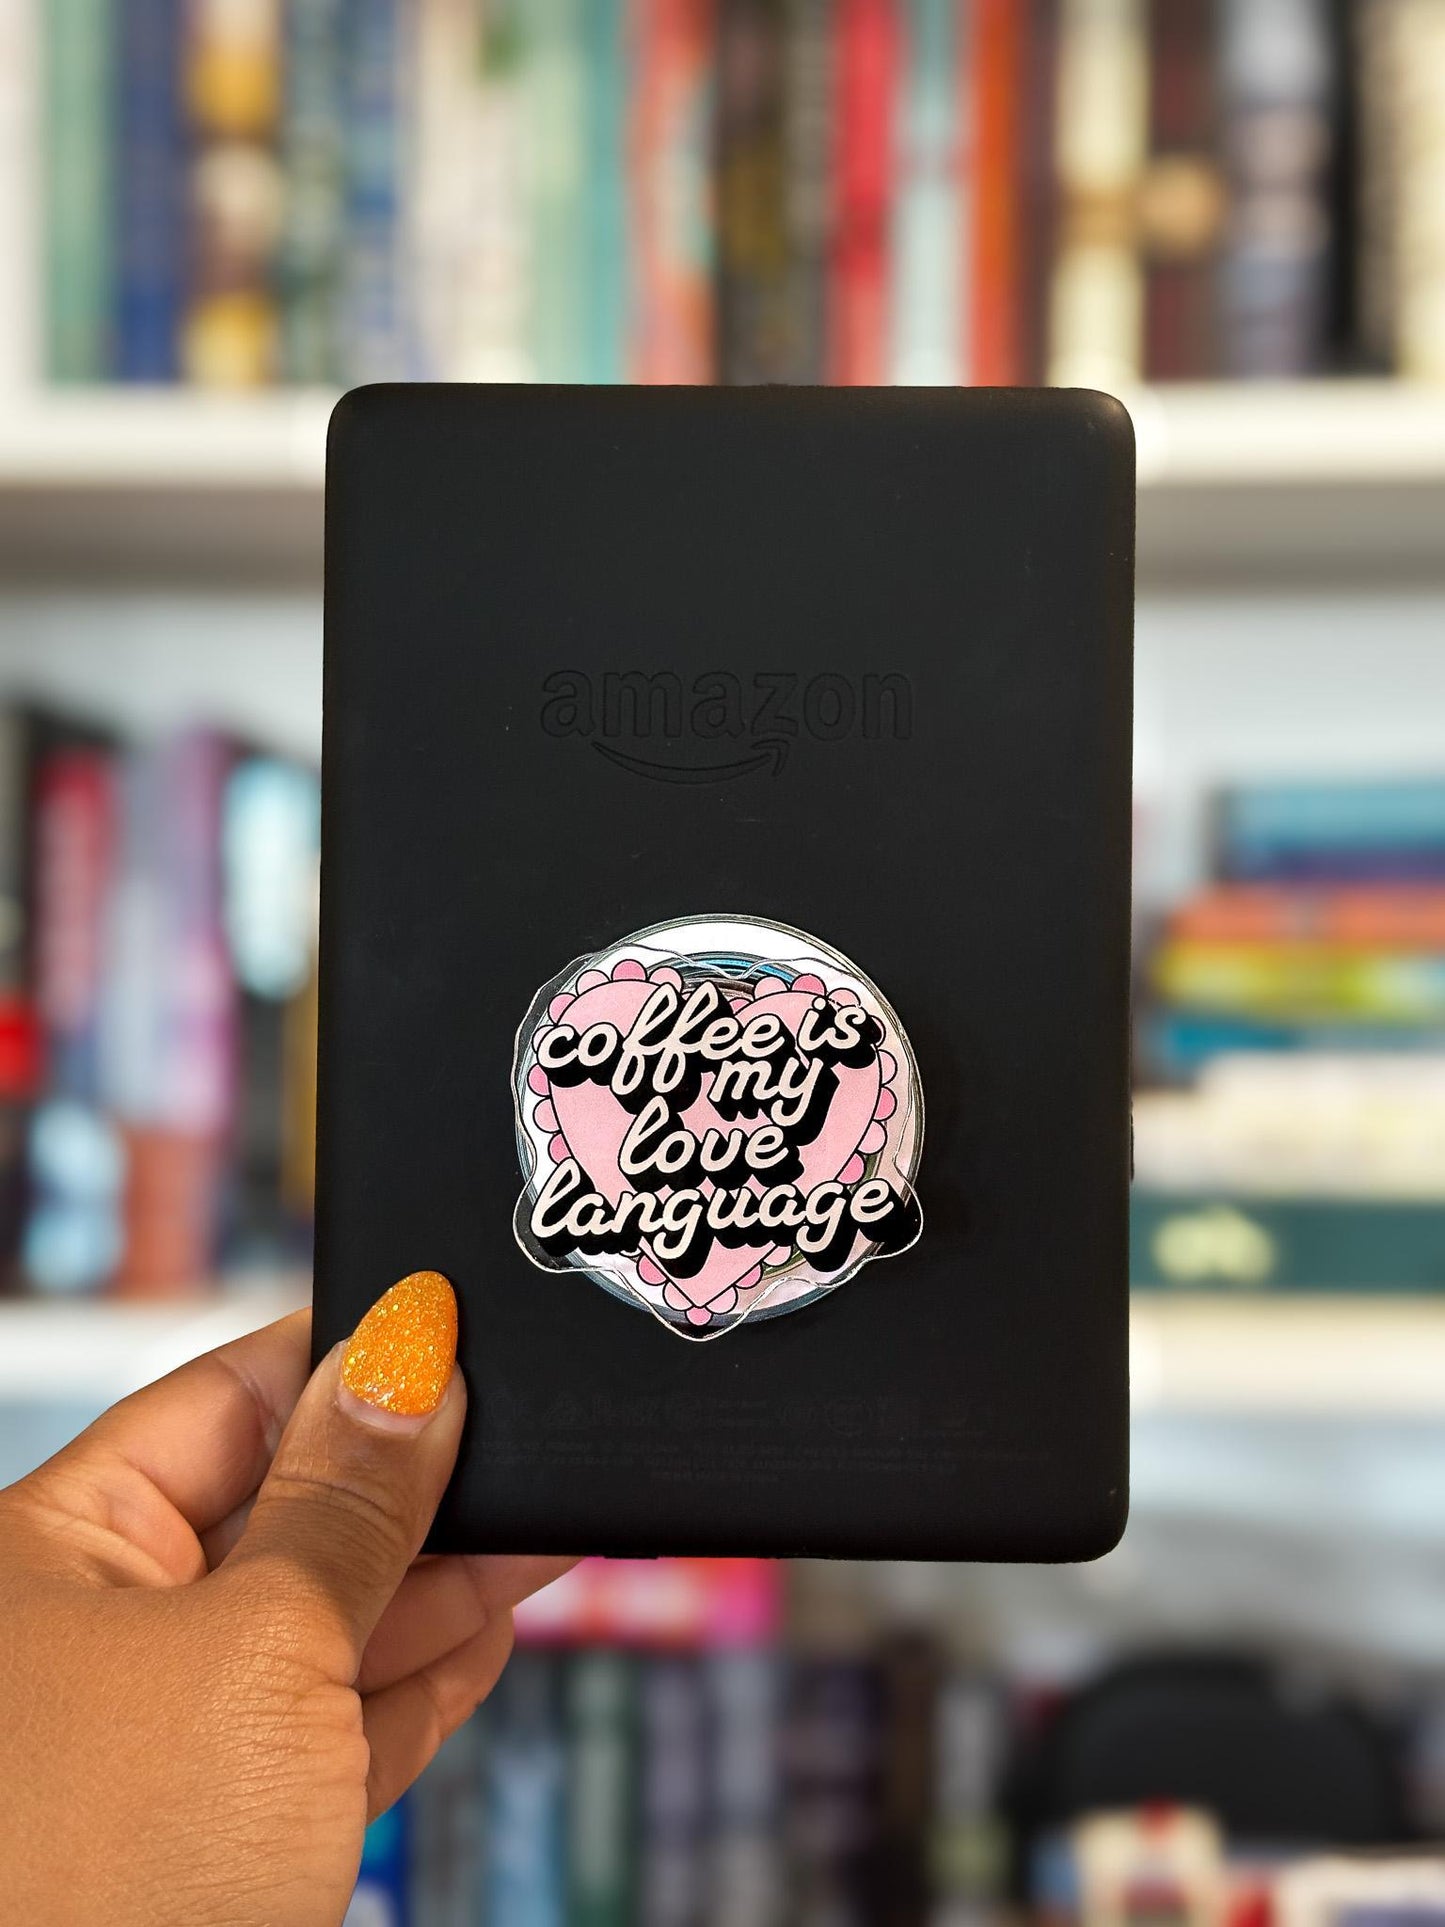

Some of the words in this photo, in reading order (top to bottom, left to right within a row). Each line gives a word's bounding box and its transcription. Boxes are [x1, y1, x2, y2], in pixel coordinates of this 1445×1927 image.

[540, 669, 912, 740] amazon
[537, 981, 786, 1096] coffee
[798, 997, 868, 1051] is
[709, 1056, 825, 1127] my
[619, 1096, 790, 1176] love
[530, 1156, 895, 1261] language
